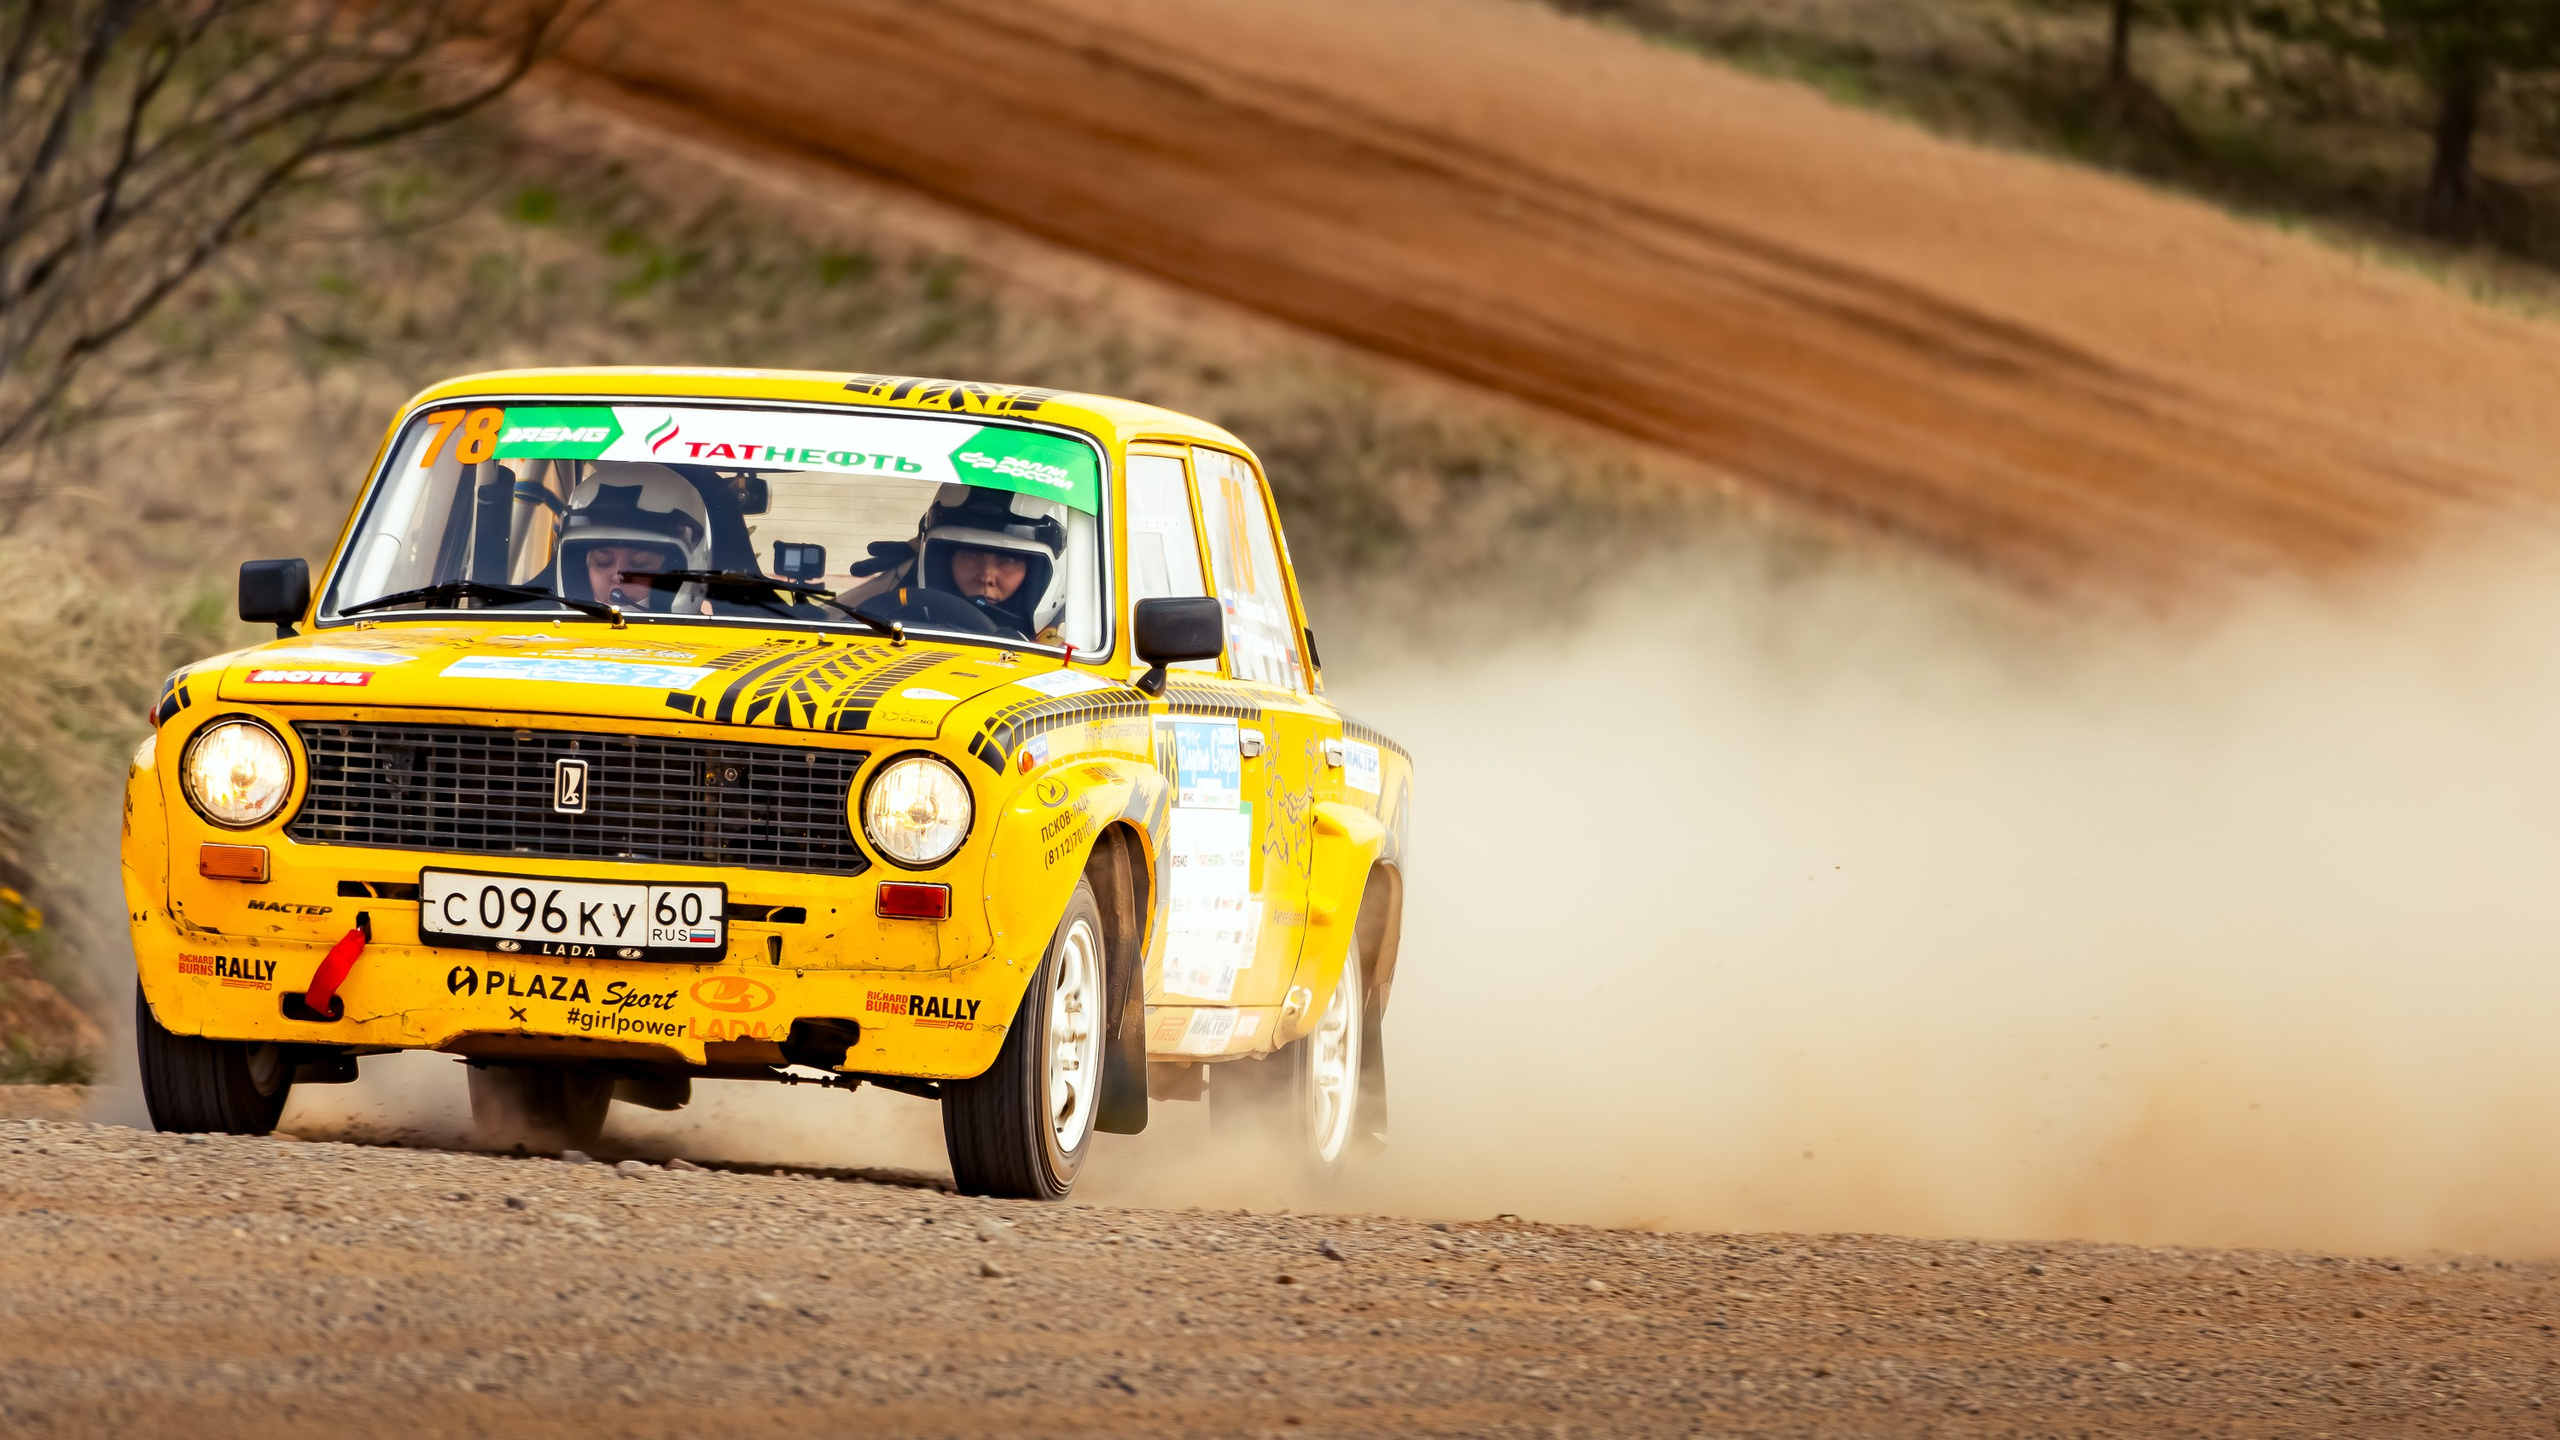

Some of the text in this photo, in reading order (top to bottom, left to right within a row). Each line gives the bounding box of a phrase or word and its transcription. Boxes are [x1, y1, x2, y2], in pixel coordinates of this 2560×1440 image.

[420, 407, 505, 468] 78
[685, 441, 923, 473] ТАТНЕФТЬ
[253, 670, 364, 685] MOTUL
[630, 672, 694, 686] 78
[1157, 729, 1179, 802] 78
[1040, 792, 1092, 843] ПСКОВ-ЛАДА
[247, 900, 333, 916] МАСТЕР
[655, 892, 702, 926] 60
[652, 929, 688, 942] RUS
[543, 943, 596, 957] LADA
[178, 953, 214, 965] RICHARD
[178, 962, 214, 977] BURNS
[215, 956, 277, 981] RALLY
[249, 981, 272, 991] PRO
[485, 971, 679, 1013] PLAZA Sport
[867, 991, 908, 1003] RICHARD
[866, 1000, 907, 1015] BURNS
[908, 995, 981, 1021] RALLY
[567, 1008, 687, 1038] #girlpower
[688, 1017, 769, 1041] LADA
[946, 1020, 974, 1031] PRO
